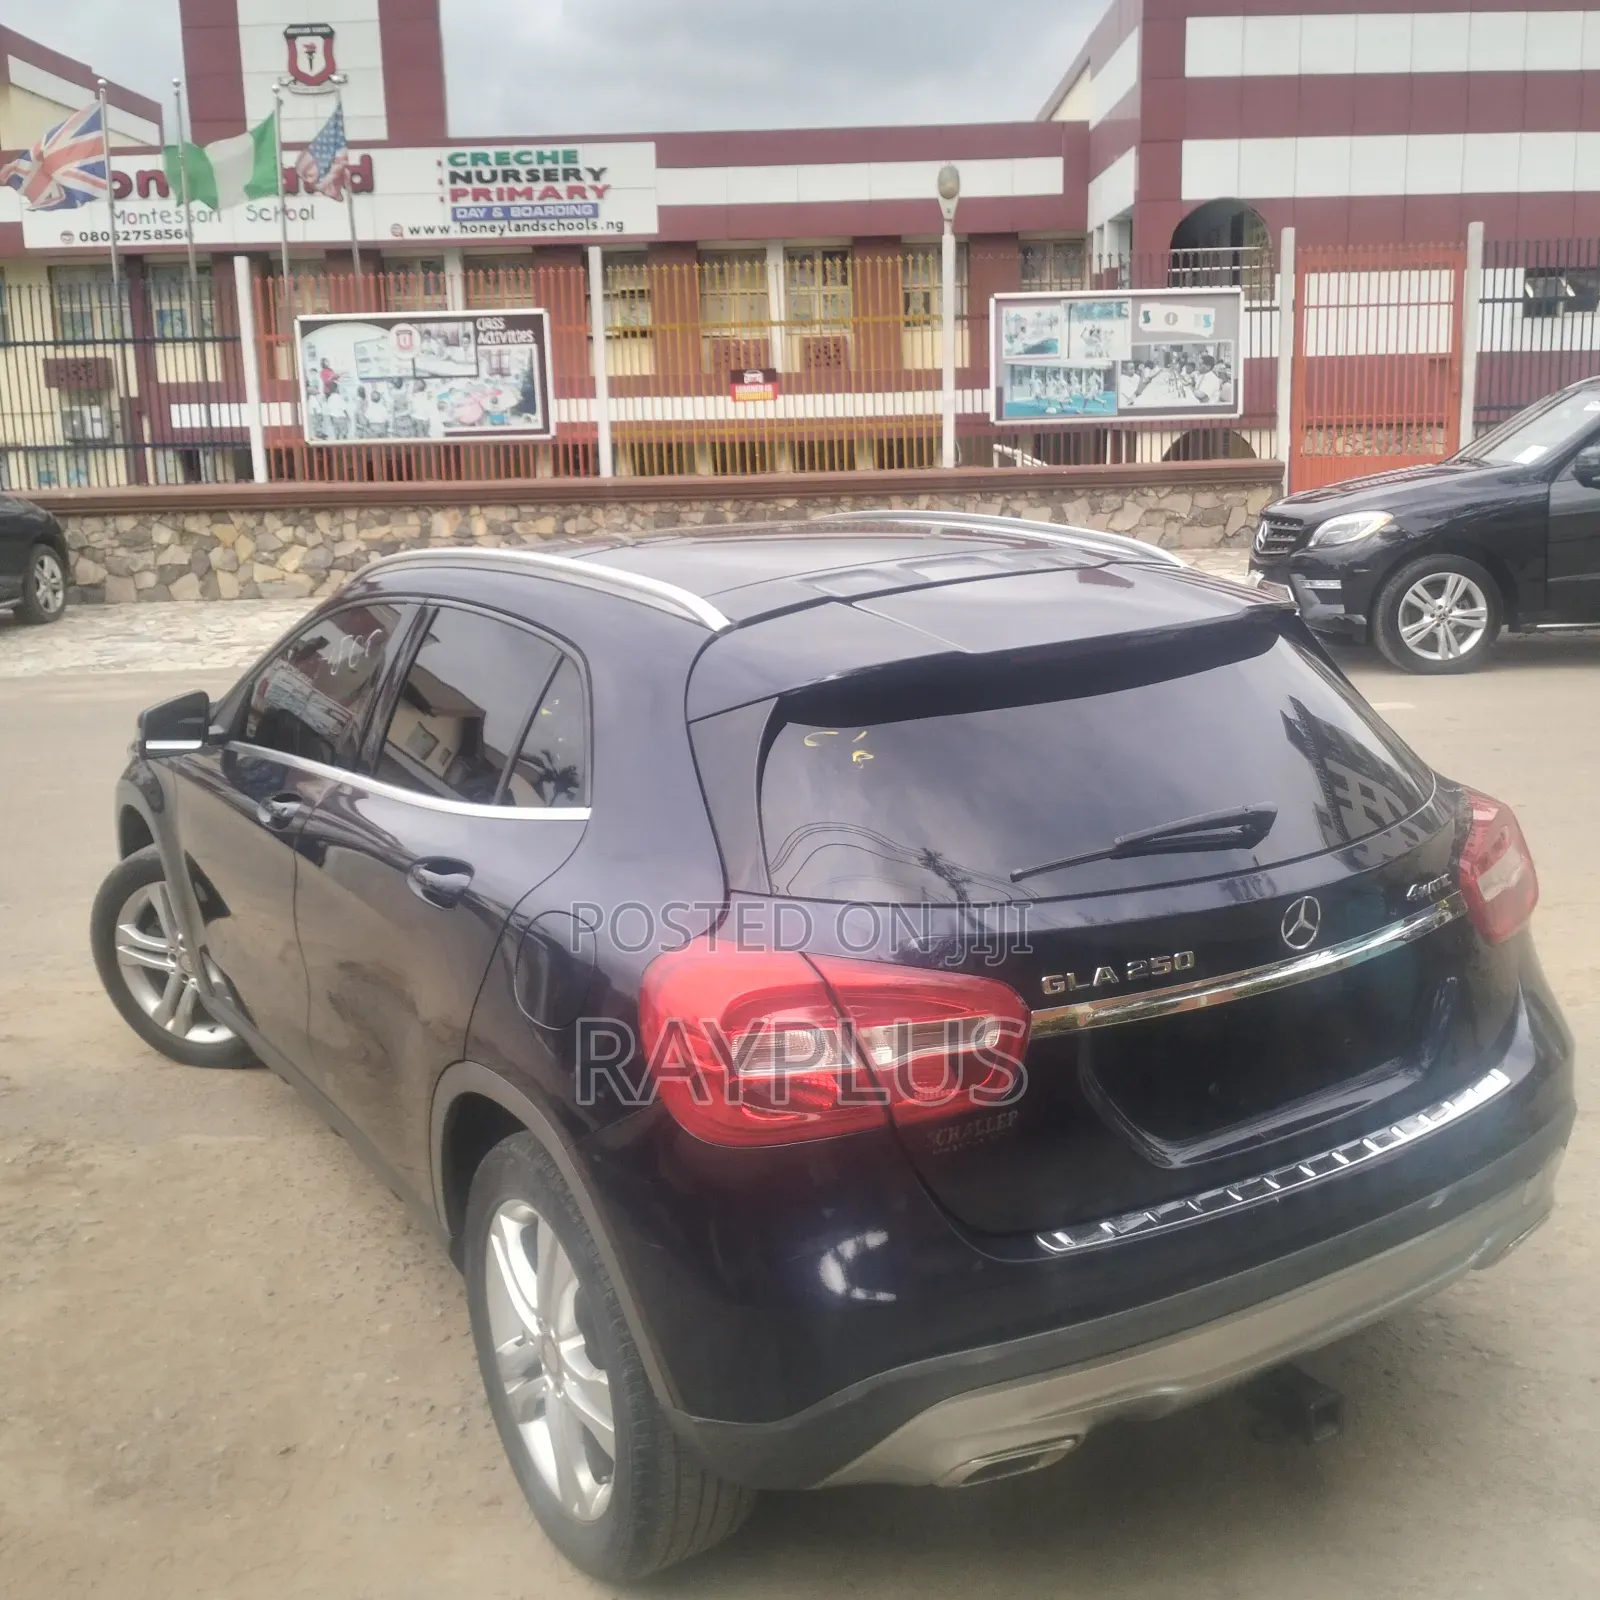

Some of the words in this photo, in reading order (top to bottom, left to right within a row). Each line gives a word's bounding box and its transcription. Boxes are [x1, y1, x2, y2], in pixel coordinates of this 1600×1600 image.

[448, 149, 579, 168] CRECHE
[450, 167, 608, 186] NURSERY
[450, 184, 611, 203] PRIMARY
[246, 203, 315, 222] School
[455, 207, 488, 219] DAY
[492, 206, 504, 218] &
[510, 203, 594, 217] BOARDING
[408, 218, 624, 237] www.honeylandschools.ng
[1041, 965, 1120, 995] GLA
[1126, 950, 1195, 981] 250
